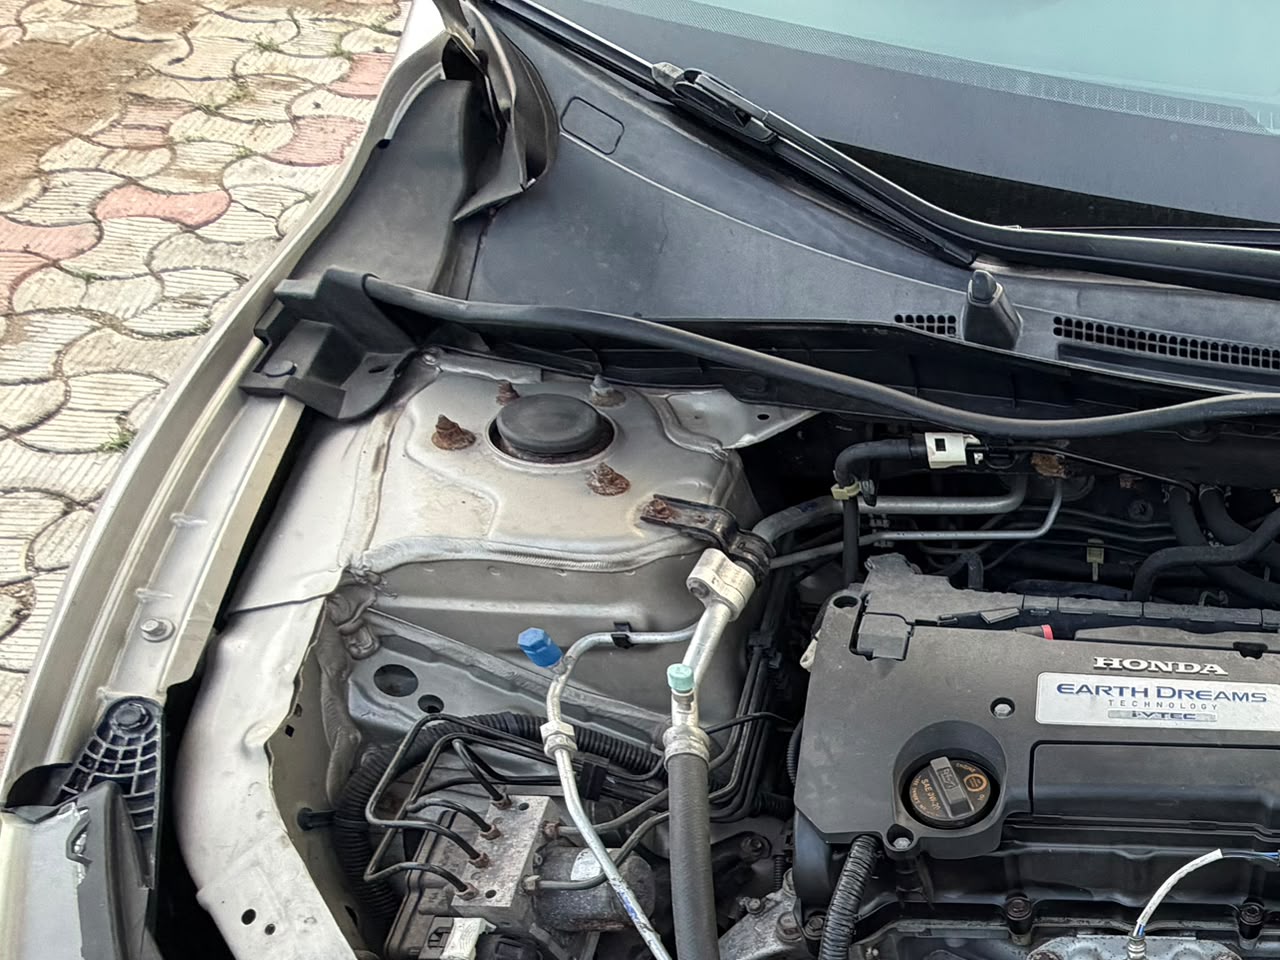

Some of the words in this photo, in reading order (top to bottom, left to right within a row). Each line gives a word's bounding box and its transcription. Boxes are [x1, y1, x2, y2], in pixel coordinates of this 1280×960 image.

[1093, 656, 1229, 676] HONDA
[1056, 683, 1149, 698] EARTH
[1156, 686, 1268, 703] DREAMS
[1108, 700, 1218, 710] TECHNOLOGY
[1131, 710, 1197, 720] i-VTEC
[921, 778, 932, 792] SAE
